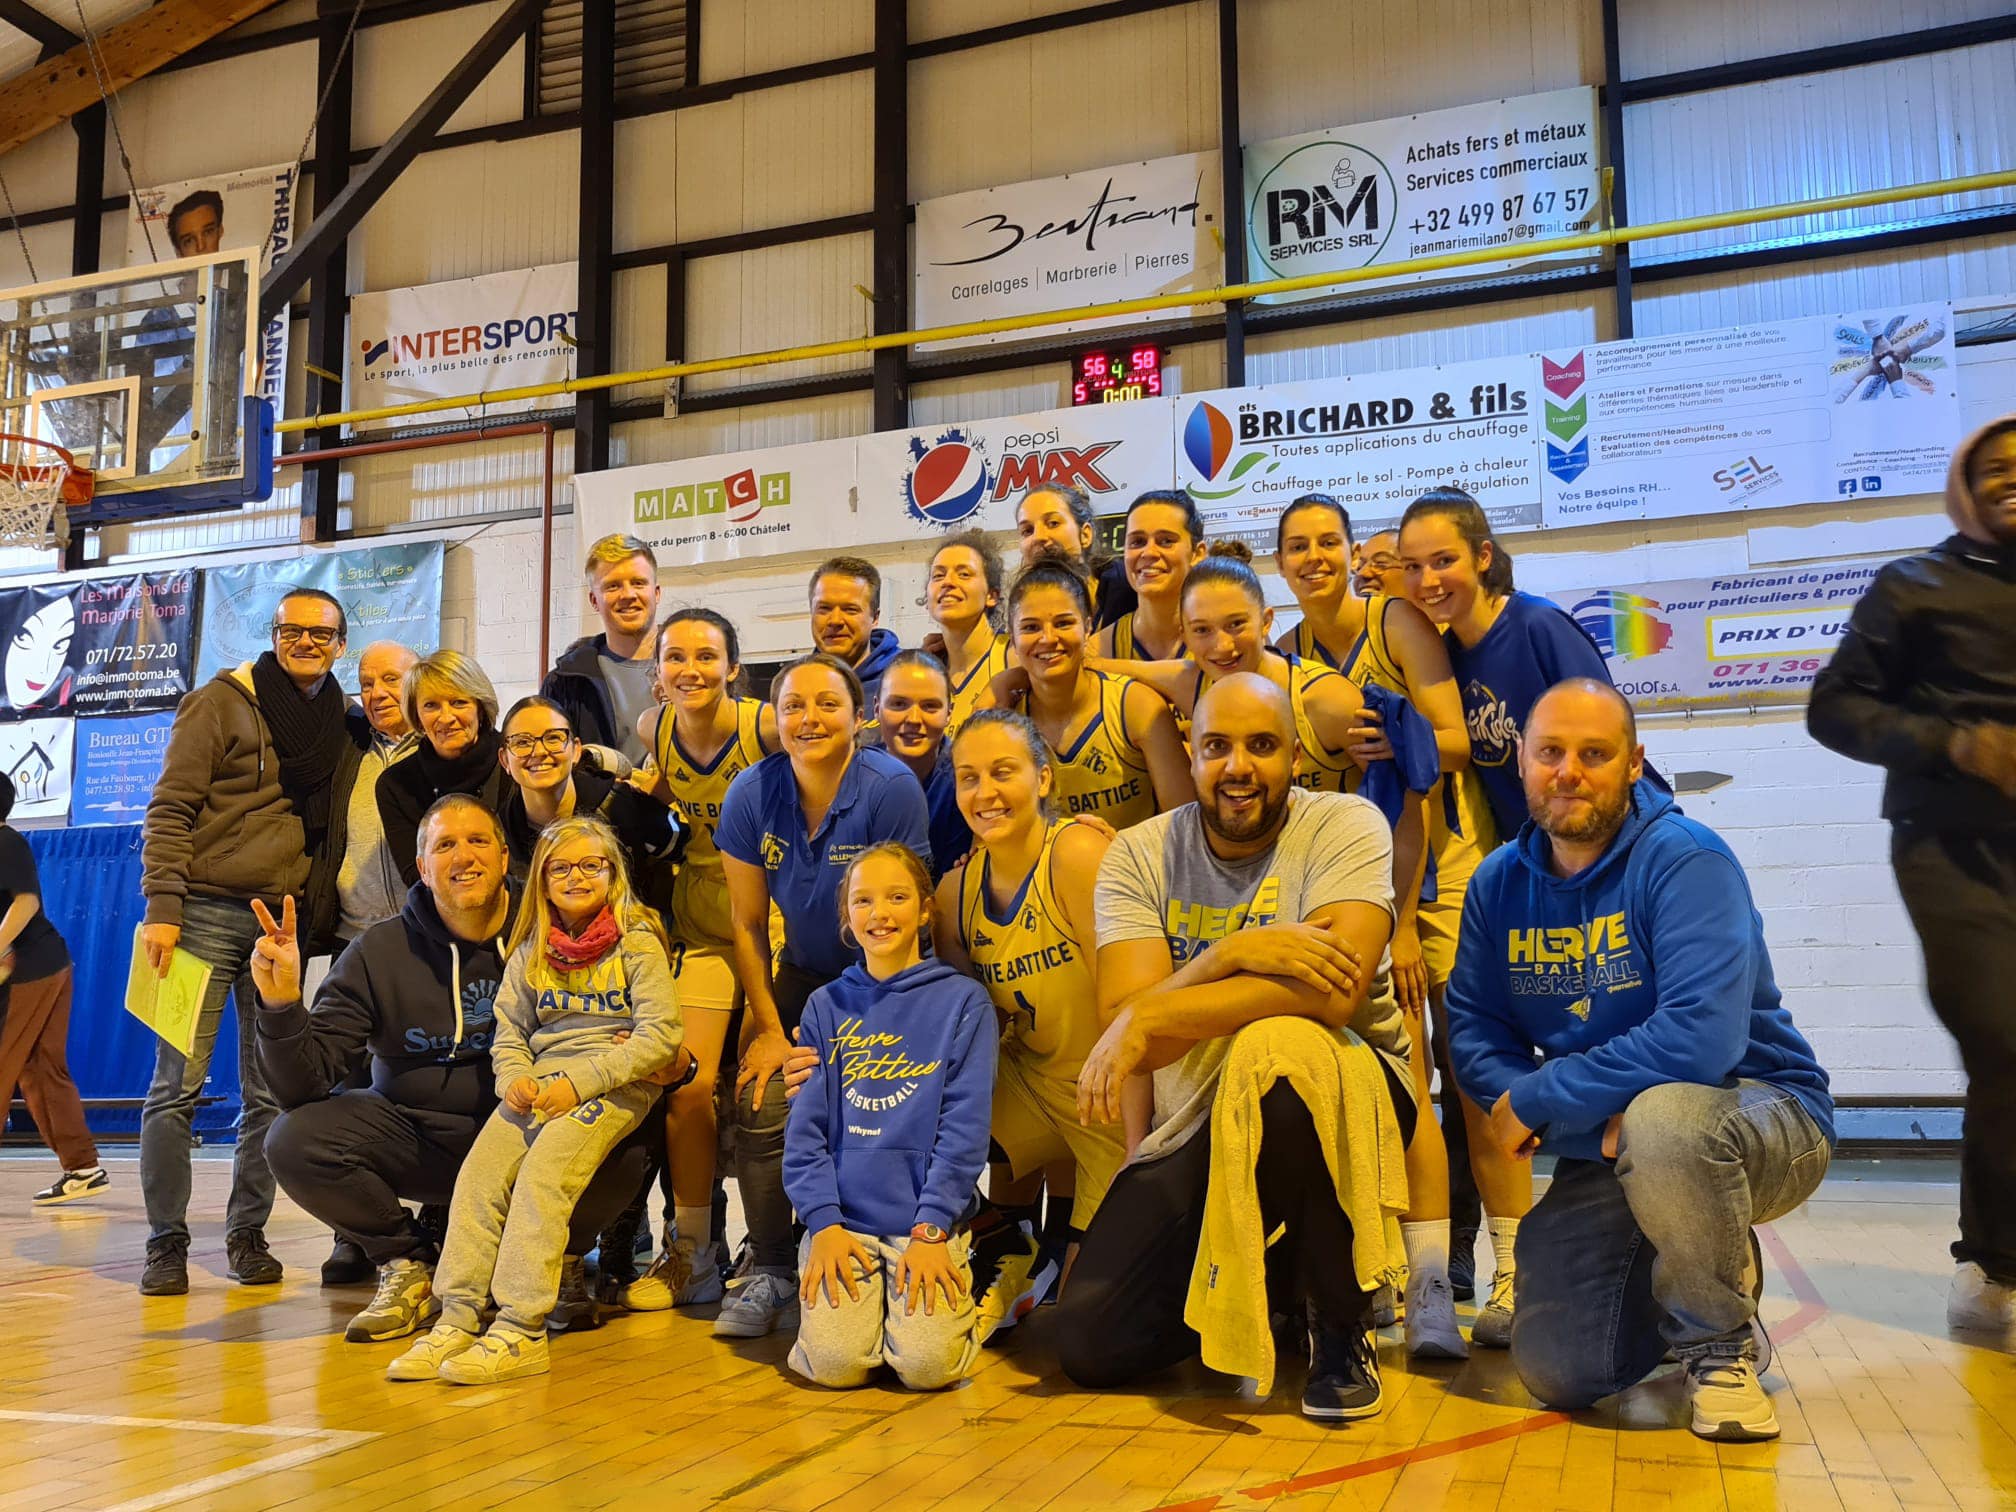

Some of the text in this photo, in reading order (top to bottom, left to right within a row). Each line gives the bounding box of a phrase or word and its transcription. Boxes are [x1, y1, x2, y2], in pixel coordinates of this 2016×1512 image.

[1406, 123, 1587, 164] Achats fers et métaux
[1407, 151, 1588, 191] Services commerciaux
[929, 170, 1203, 265] Bertrand
[1267, 174, 1379, 247] RM
[1409, 187, 1589, 235] +32 499 87 67 57
[1270, 233, 1380, 261] SERVICES SRL
[1409, 219, 1591, 258] jeanmariemilano7@gmail.com
[951, 251, 1190, 300] Carrelages Marbrerie Pierres
[1596, 340, 1681, 358] Accompagnement
[1684, 332, 1748, 347] personnalisé
[1750, 330, 1762, 338] de
[1596, 353, 1643, 365] travailleurs
[1646, 351, 1666, 360] pour
[1669, 348, 1682, 356] les
[1725, 341, 1743, 349] une
[365, 371, 376, 382] Le
[380, 366, 415, 380] sport,
[418, 364, 428, 375] la
[431, 361, 456, 375] plus
[460, 356, 489, 369] belle
[493, 353, 514, 364] des
[1111, 363, 1123, 379] 4
[1597, 361, 1653, 375] performance
[1598, 389, 1636, 400] Ateliers
[1637, 388, 1646, 396] et
[1648, 382, 1704, 394] Formations
[1706, 380, 1721, 388] sur
[1760, 372, 1783, 381] dans
[1599, 396, 1645, 408] différentes
[1742, 379, 1790, 392] leadership
[1238, 402, 1257, 413] ets
[1240, 382, 1528, 440] BRICHARD & fils
[1599, 409, 1615, 417] aux
[1617, 402, 1676, 414] compétences
[1004, 427, 1060, 451] pepsi
[1272, 420, 1529, 458] Toutes applications du chauffage
[1600, 423, 1725, 443] Recrutement/Headhunting
[1601, 427, 1772, 453] Evaluation des compétences de vos
[1601, 448, 1663, 461] collaborateurs
[990, 440, 1124, 503] MAX
[1252, 475, 1323, 494] Chauffage
[1328, 475, 1352, 490] par
[1357, 471, 1369, 484] le
[1374, 469, 1393, 482] sol
[1407, 463, 1455, 480] Pompe
[1460, 460, 1469, 473] à
[1474, 456, 1529, 472] chaleur
[1452, 474, 1529, 494] Régulation
[1713, 455, 1774, 491] SEL
[637, 476, 785, 518] MATCH
[1558, 482, 1671, 501] Vos Besoins RH...
[1559, 503, 1593, 514] Notre
[1596, 498, 1639, 511] équipe
[661, 537, 674, 547] du
[676, 534, 707, 548] perron
[709, 531, 716, 540] 8
[749, 522, 791, 536] Châtelet
[81, 586, 103, 604] Les
[172, 580, 189, 593] de
[1711, 575, 1794, 592] Fabricant
[1797, 573, 1819, 584] de
[149, 603, 186, 618] Toma
[1665, 588, 1824, 614] pour particuliers &
[1719, 626, 1784, 644] PRIX
[86, 642, 178, 665] 071/72.57.20
[77, 667, 180, 686] info@immotoma.be
[1713, 658, 1821, 677] 071 36
[75, 685, 178, 703] www.immotoma.be
[1660, 682, 1681, 693] S.A.
[89, 731, 140, 749] Bureau
[1067, 777, 1141, 813] BATTICE
[1007, 940, 1074, 982] BATTICE
[828, 1017, 903, 1065] Herve
[841, 1049, 942, 1088] Battice
[845, 1081, 919, 1112] BASKETBALL
